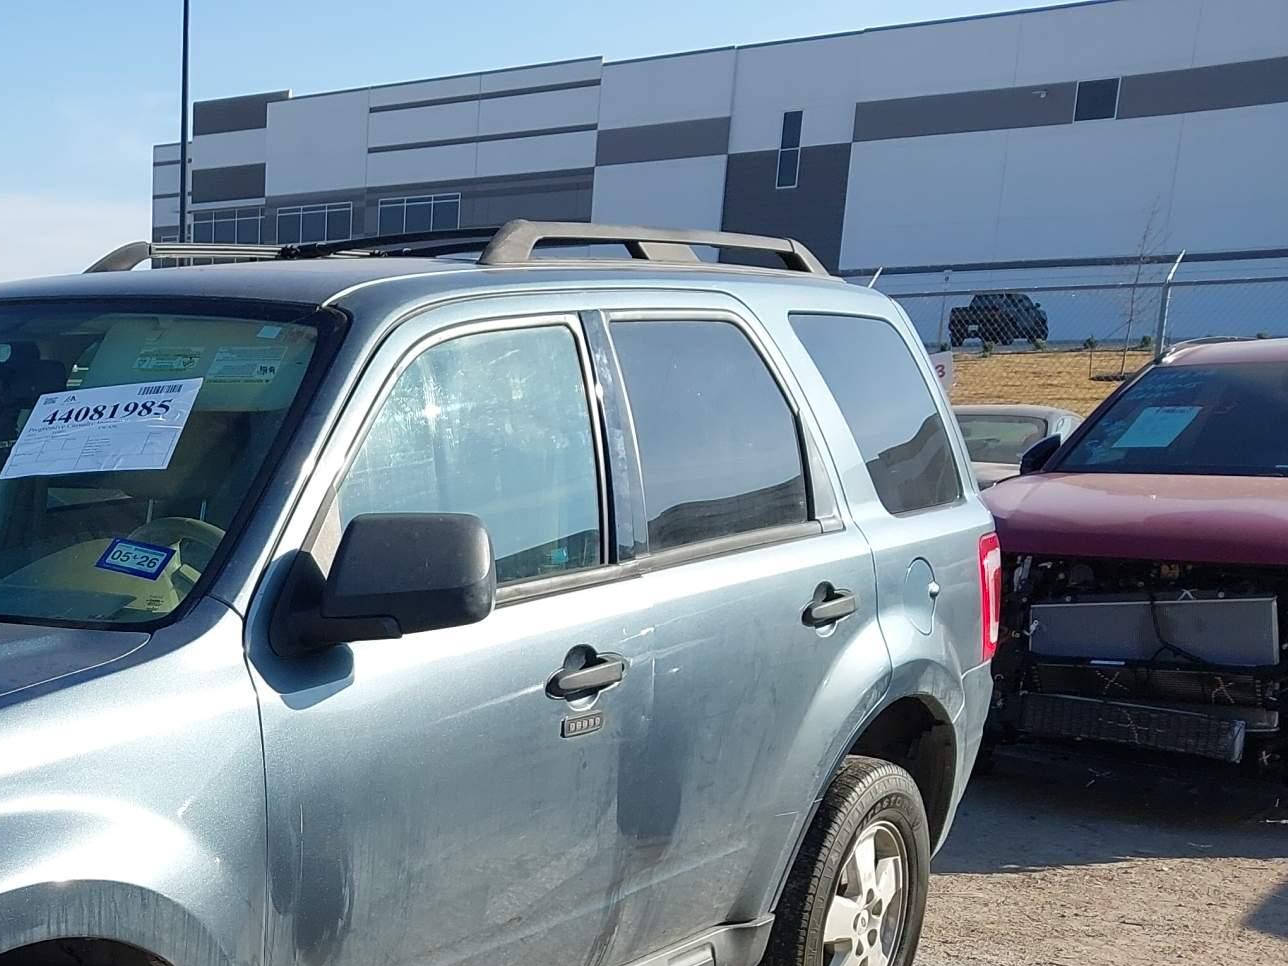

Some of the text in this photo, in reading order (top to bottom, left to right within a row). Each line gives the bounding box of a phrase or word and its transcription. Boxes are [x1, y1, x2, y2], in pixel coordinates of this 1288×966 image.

[42, 398, 174, 426] 44081985
[111, 549, 160, 569] 05 26
